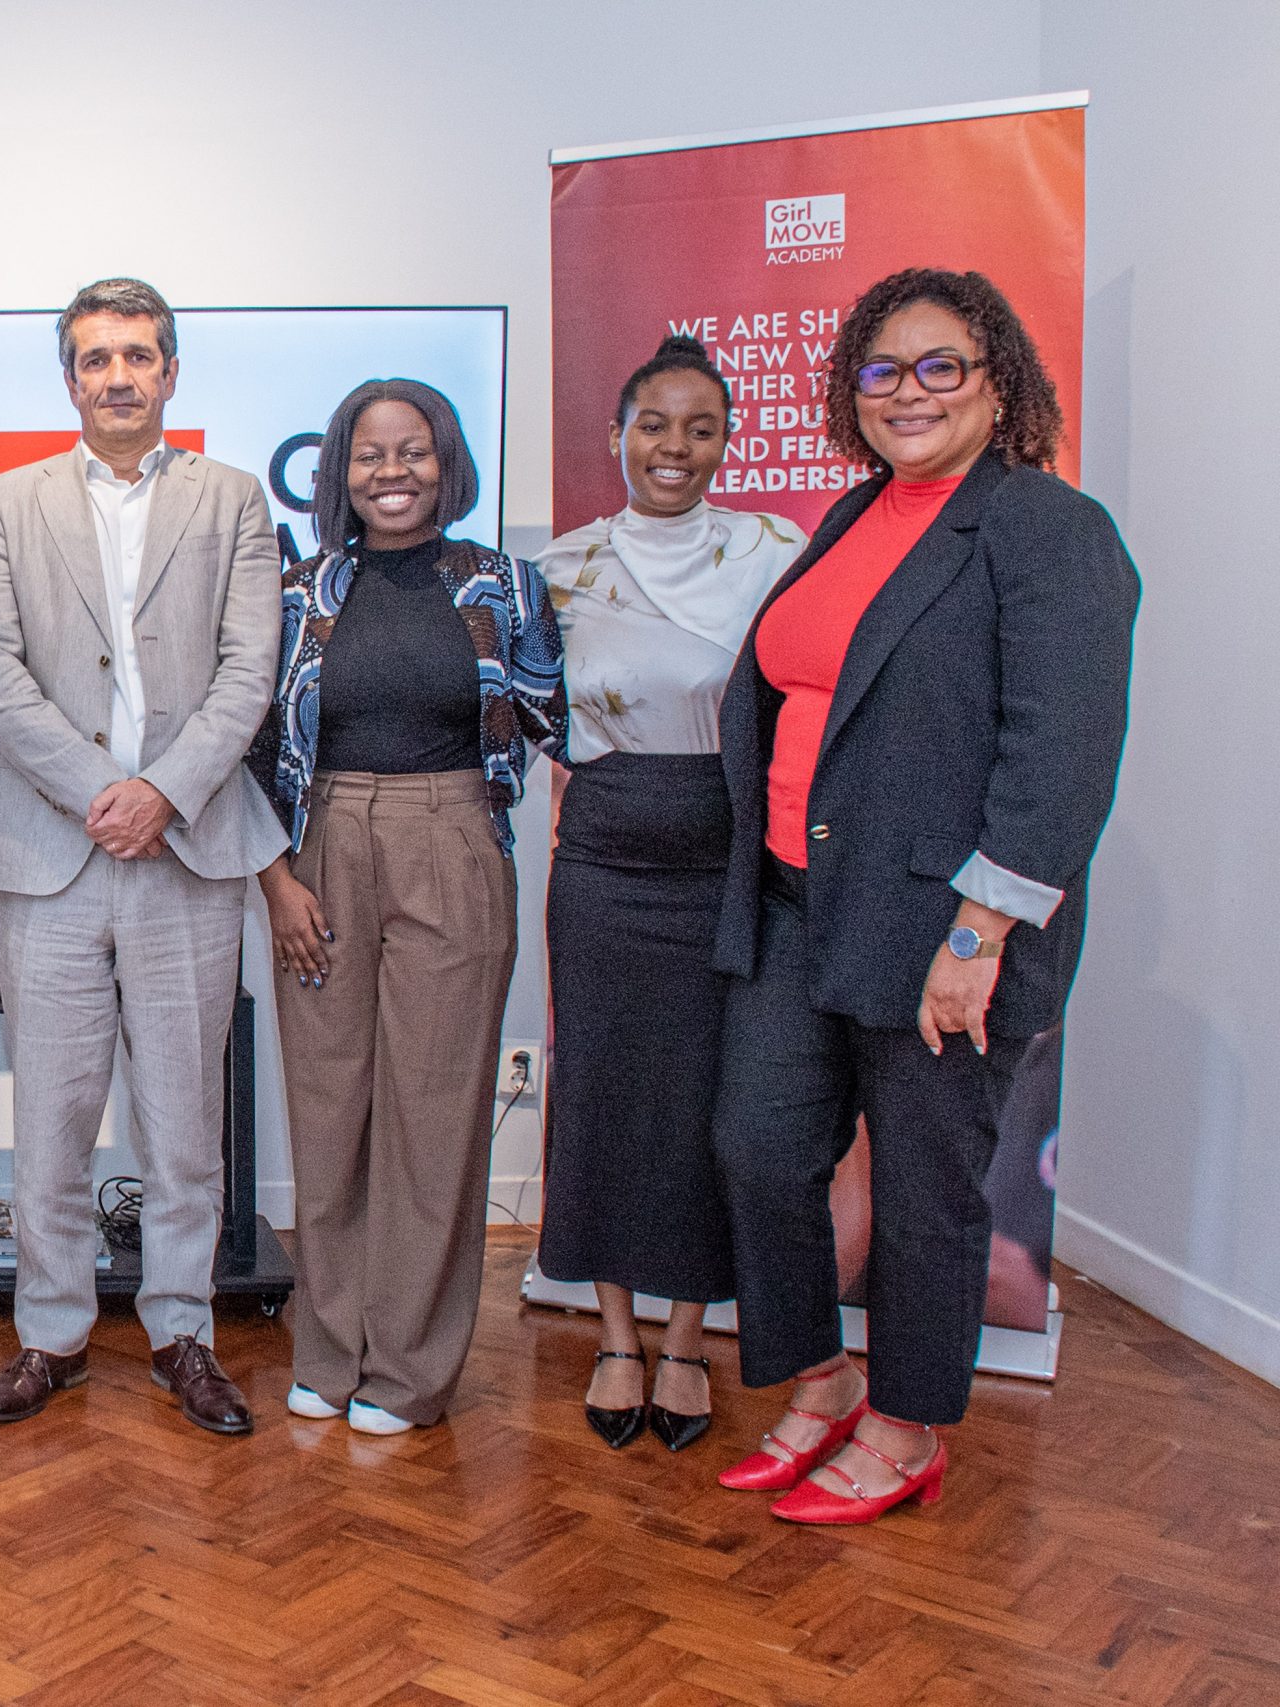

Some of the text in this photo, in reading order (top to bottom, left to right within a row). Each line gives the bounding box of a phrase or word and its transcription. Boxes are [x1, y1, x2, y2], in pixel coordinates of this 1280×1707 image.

[770, 200, 812, 223] Girl
[770, 220, 841, 245] MOVE
[766, 245, 845, 266] ACADEMY
[668, 308, 839, 342] WE ARE SH
[716, 342, 794, 372] NEW
[723, 373, 796, 401] THER
[759, 404, 824, 431] EDU
[723, 434, 835, 463] ND FEM
[708, 464, 871, 494] LEADERSH
